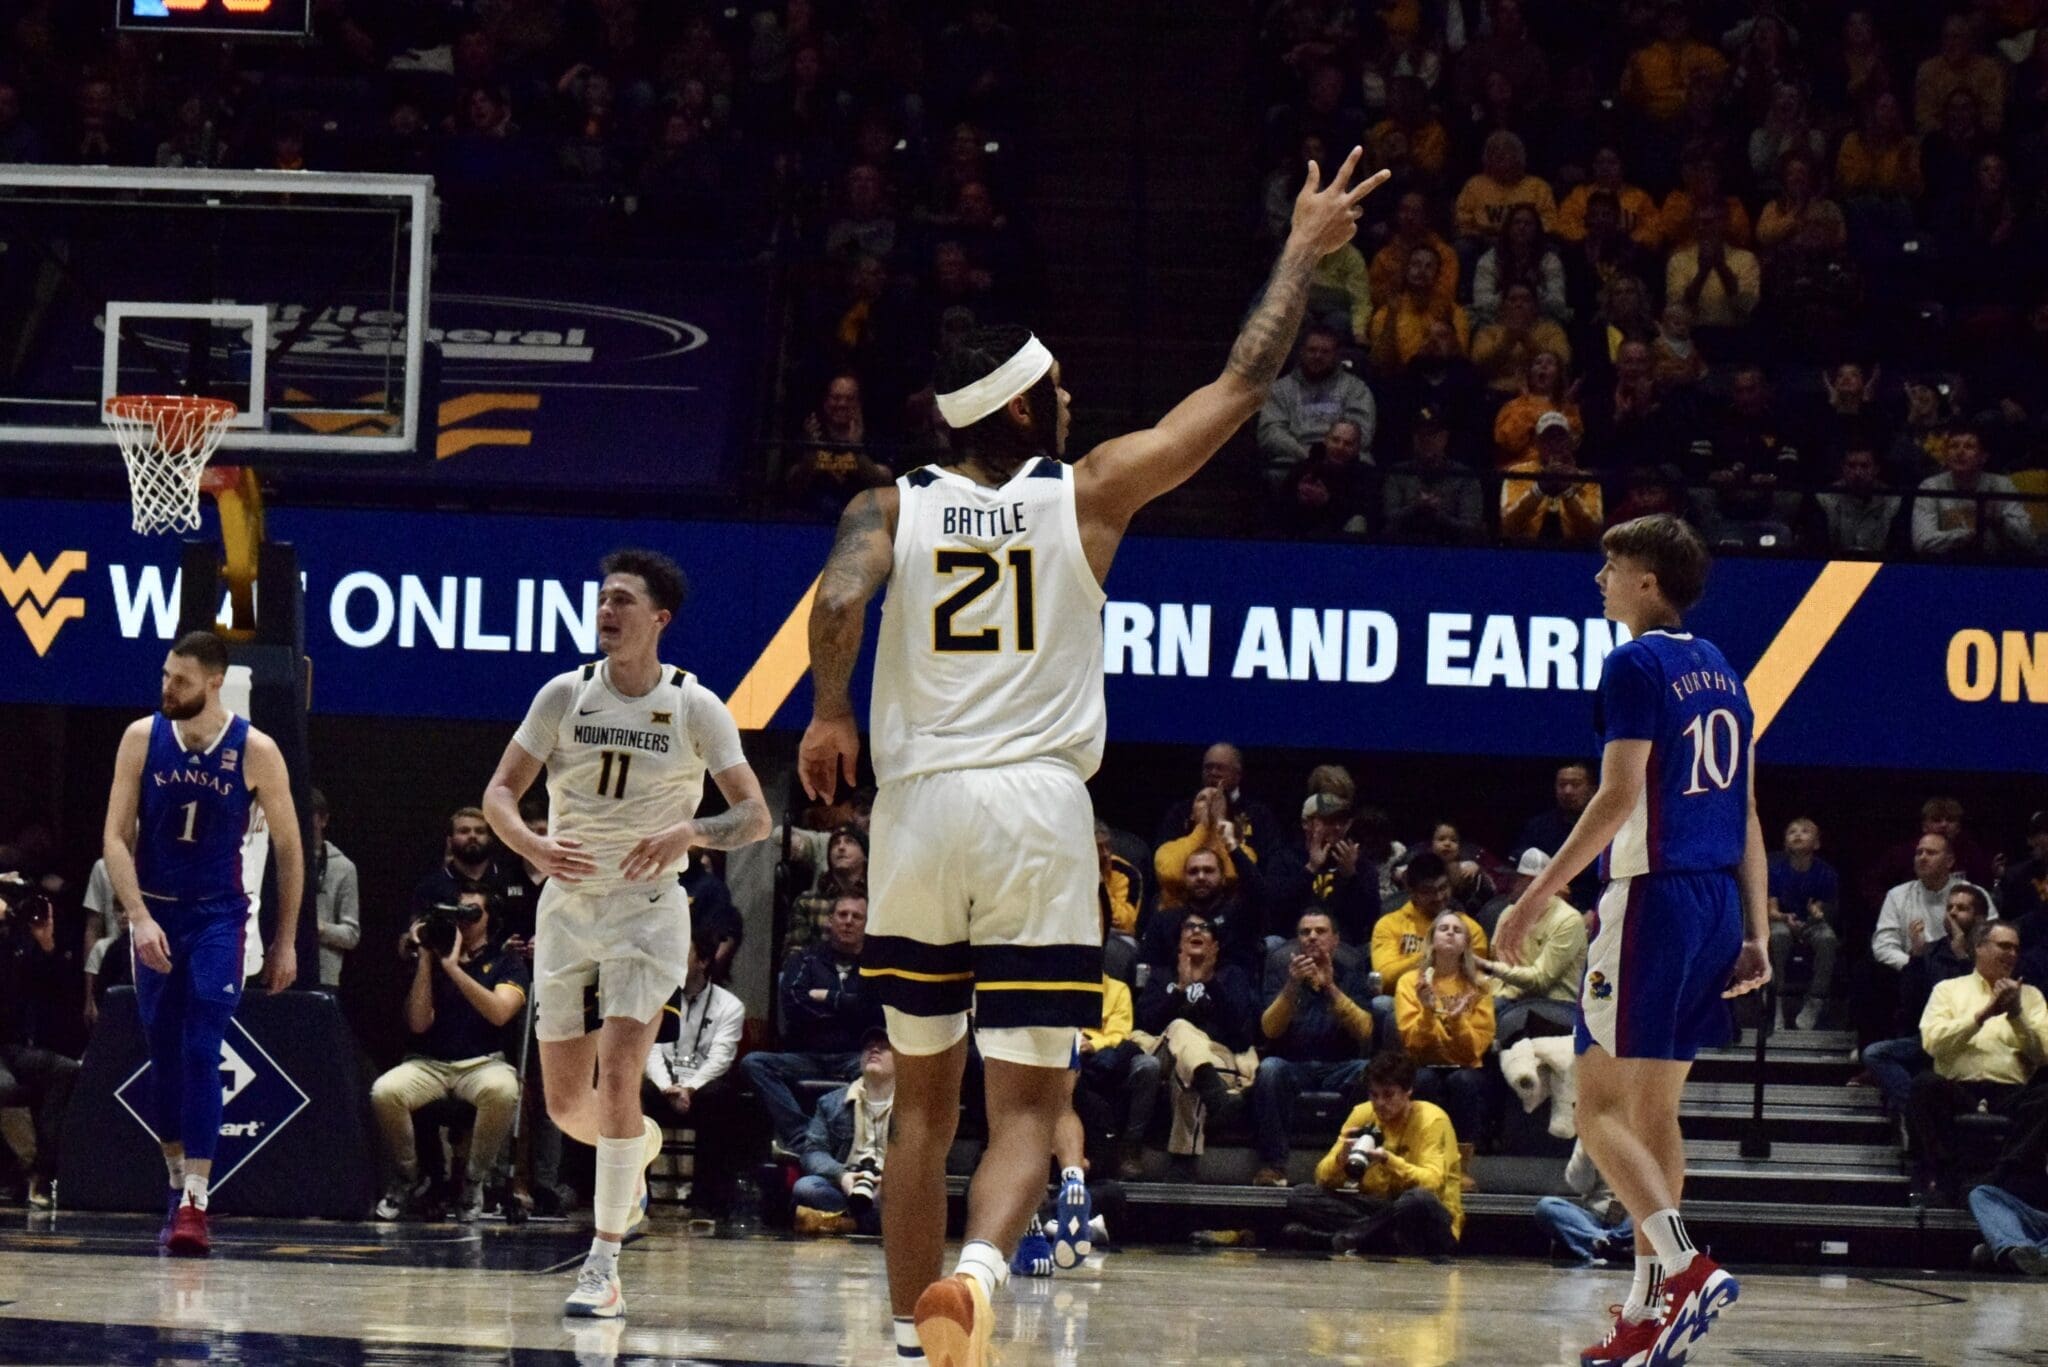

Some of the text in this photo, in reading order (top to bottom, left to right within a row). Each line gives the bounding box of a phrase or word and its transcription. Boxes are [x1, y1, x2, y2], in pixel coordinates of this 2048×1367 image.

[943, 502, 1027, 537] BATTLE
[329, 571, 600, 654] ONLIN
[932, 547, 1037, 654] 21
[1231, 606, 1399, 683] AND
[1672, 671, 1738, 701] FURPHY
[574, 725, 670, 753] MOUNTAINEERS
[1683, 708, 1740, 796] 10
[154, 769, 233, 796] KANSAS
[597, 750, 632, 800] 11
[177, 800, 198, 842] 1
[219, 1120, 259, 1137] art
